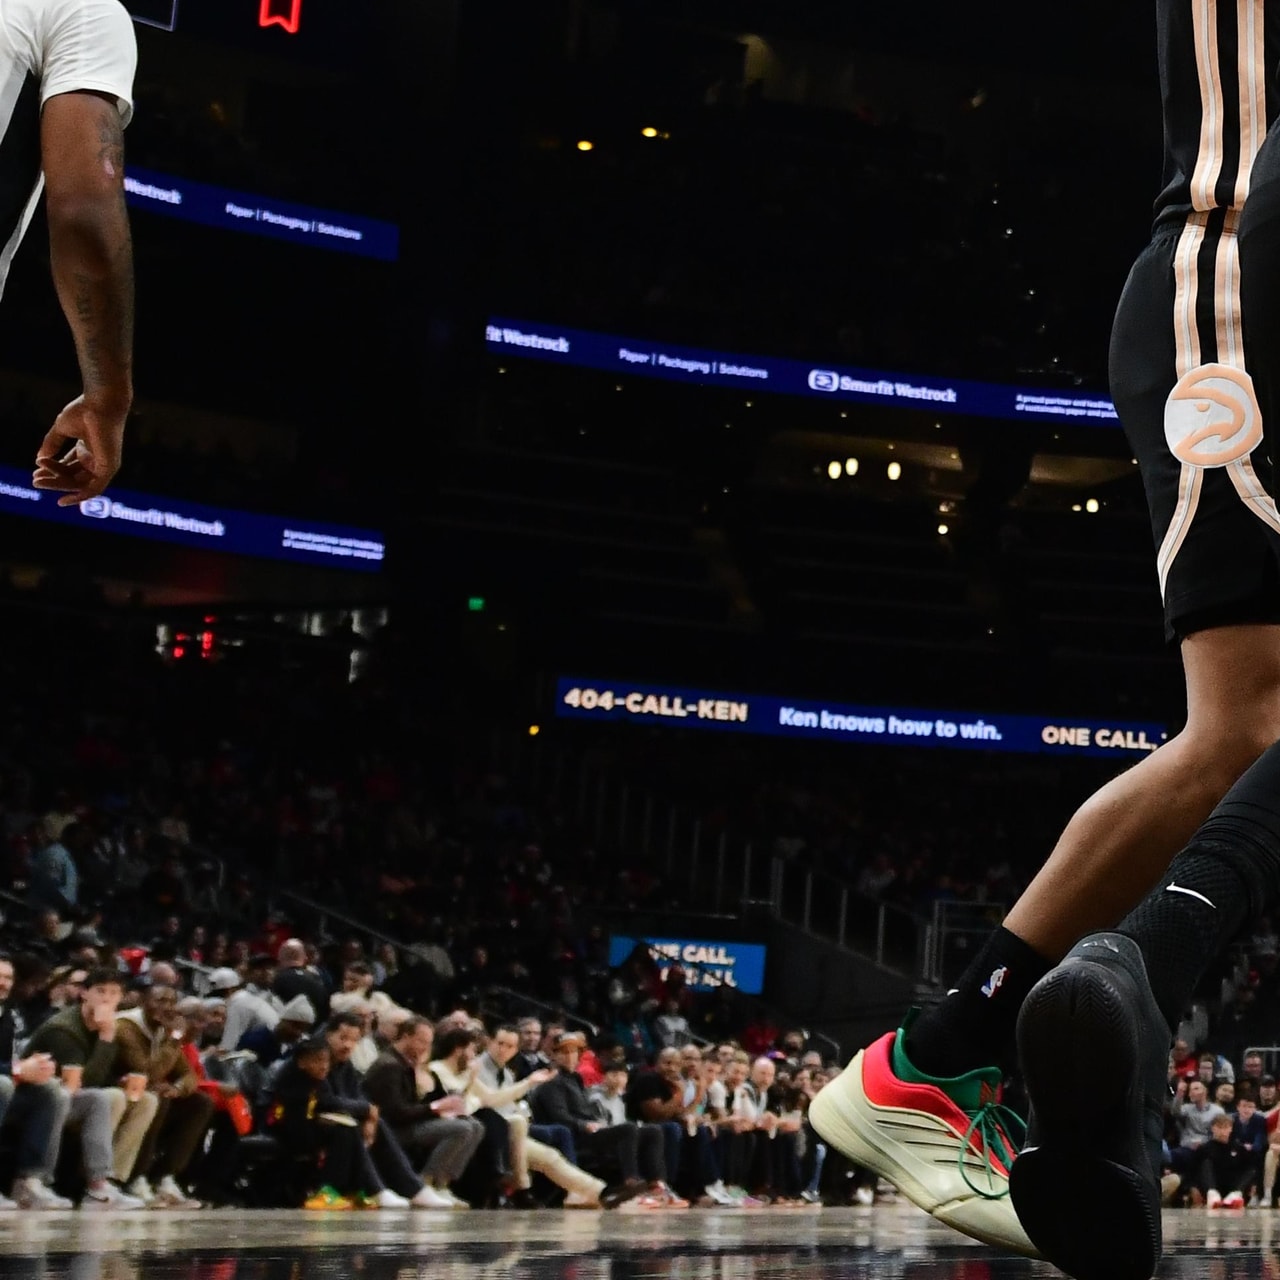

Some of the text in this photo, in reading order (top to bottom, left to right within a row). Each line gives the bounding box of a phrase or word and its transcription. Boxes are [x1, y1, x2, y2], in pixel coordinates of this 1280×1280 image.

[840, 376, 956, 402] Smurfit Westrock
[564, 688, 1158, 750] 404-CALL-KEN Ken knows how to win. ONE CALL,
